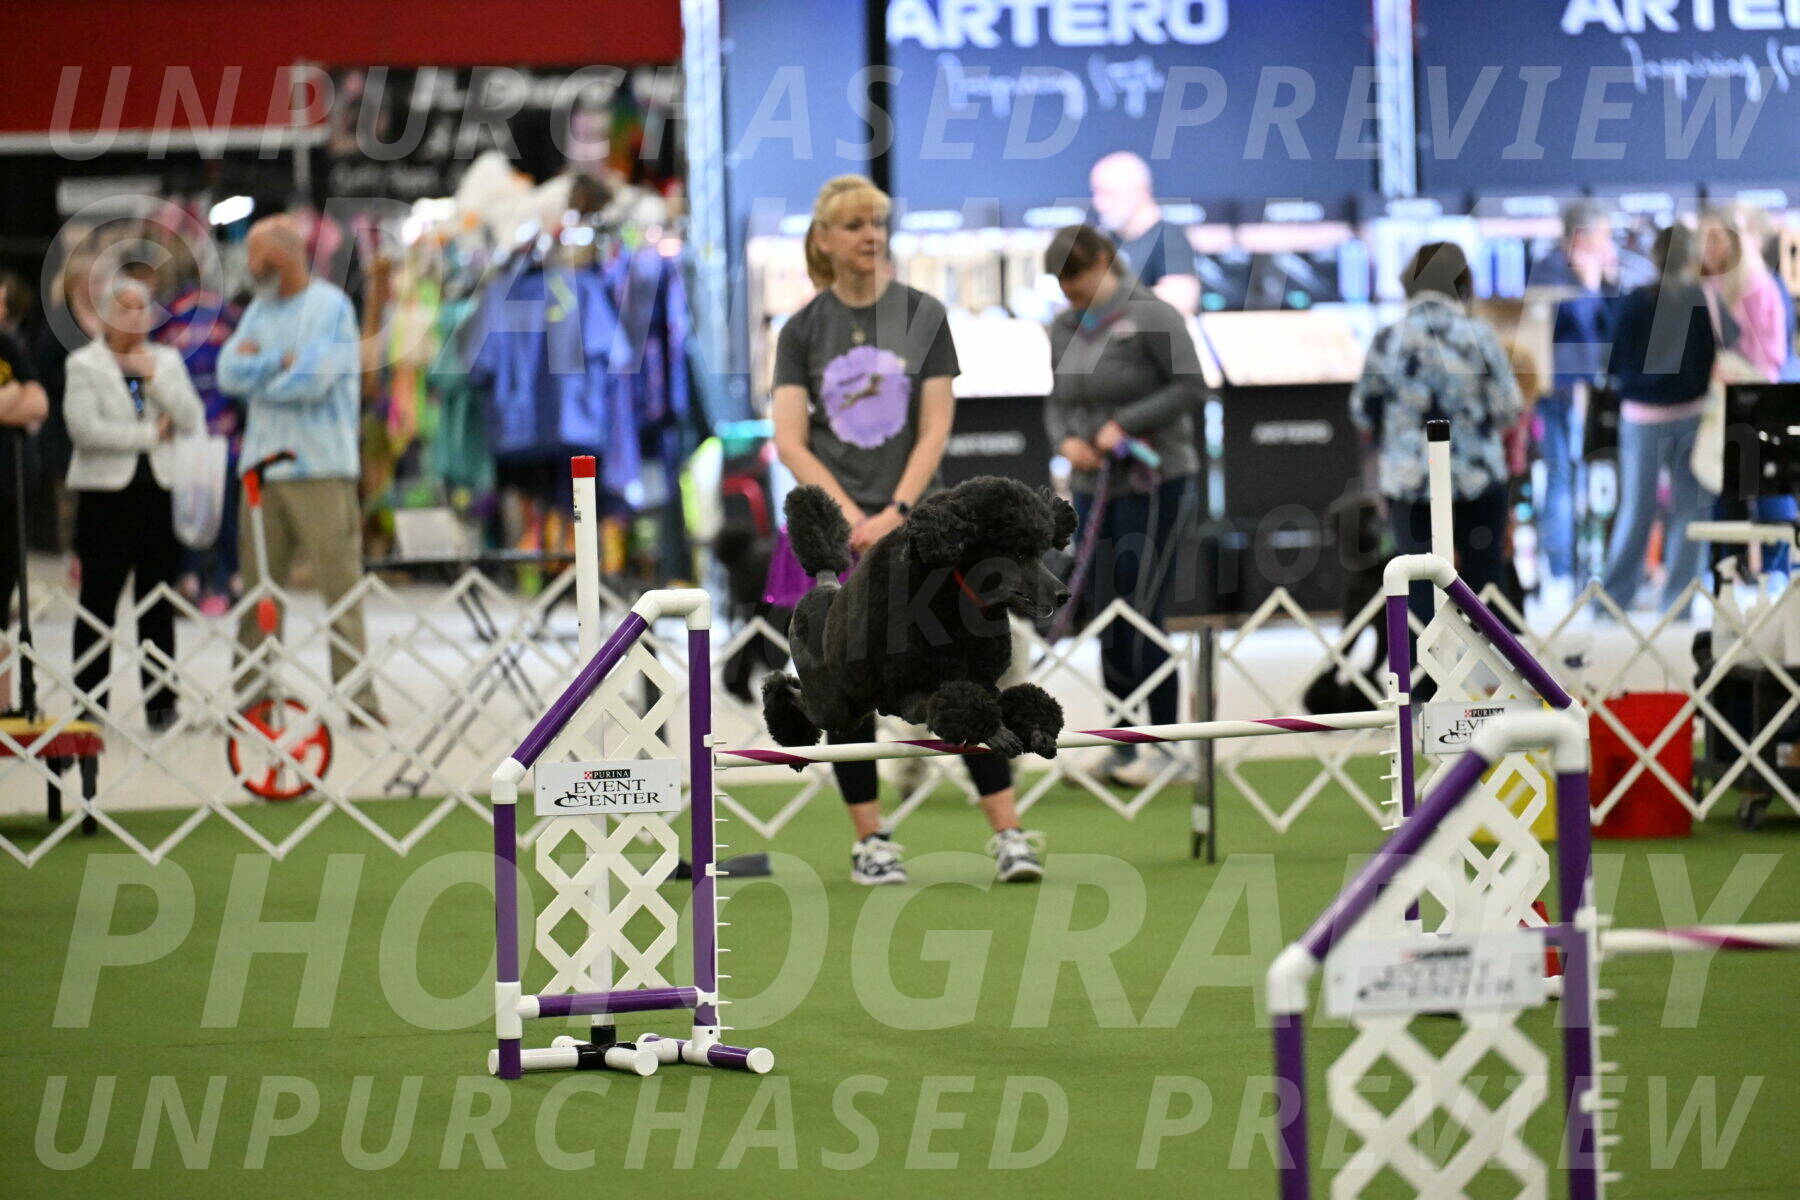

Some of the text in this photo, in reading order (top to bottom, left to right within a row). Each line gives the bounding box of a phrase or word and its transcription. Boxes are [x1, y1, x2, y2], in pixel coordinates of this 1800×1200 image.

[886, 0, 1230, 50] ARTERO
[593, 769, 631, 779] PURINA
[573, 779, 646, 794] EVENT
[554, 791, 661, 808] CENTER
